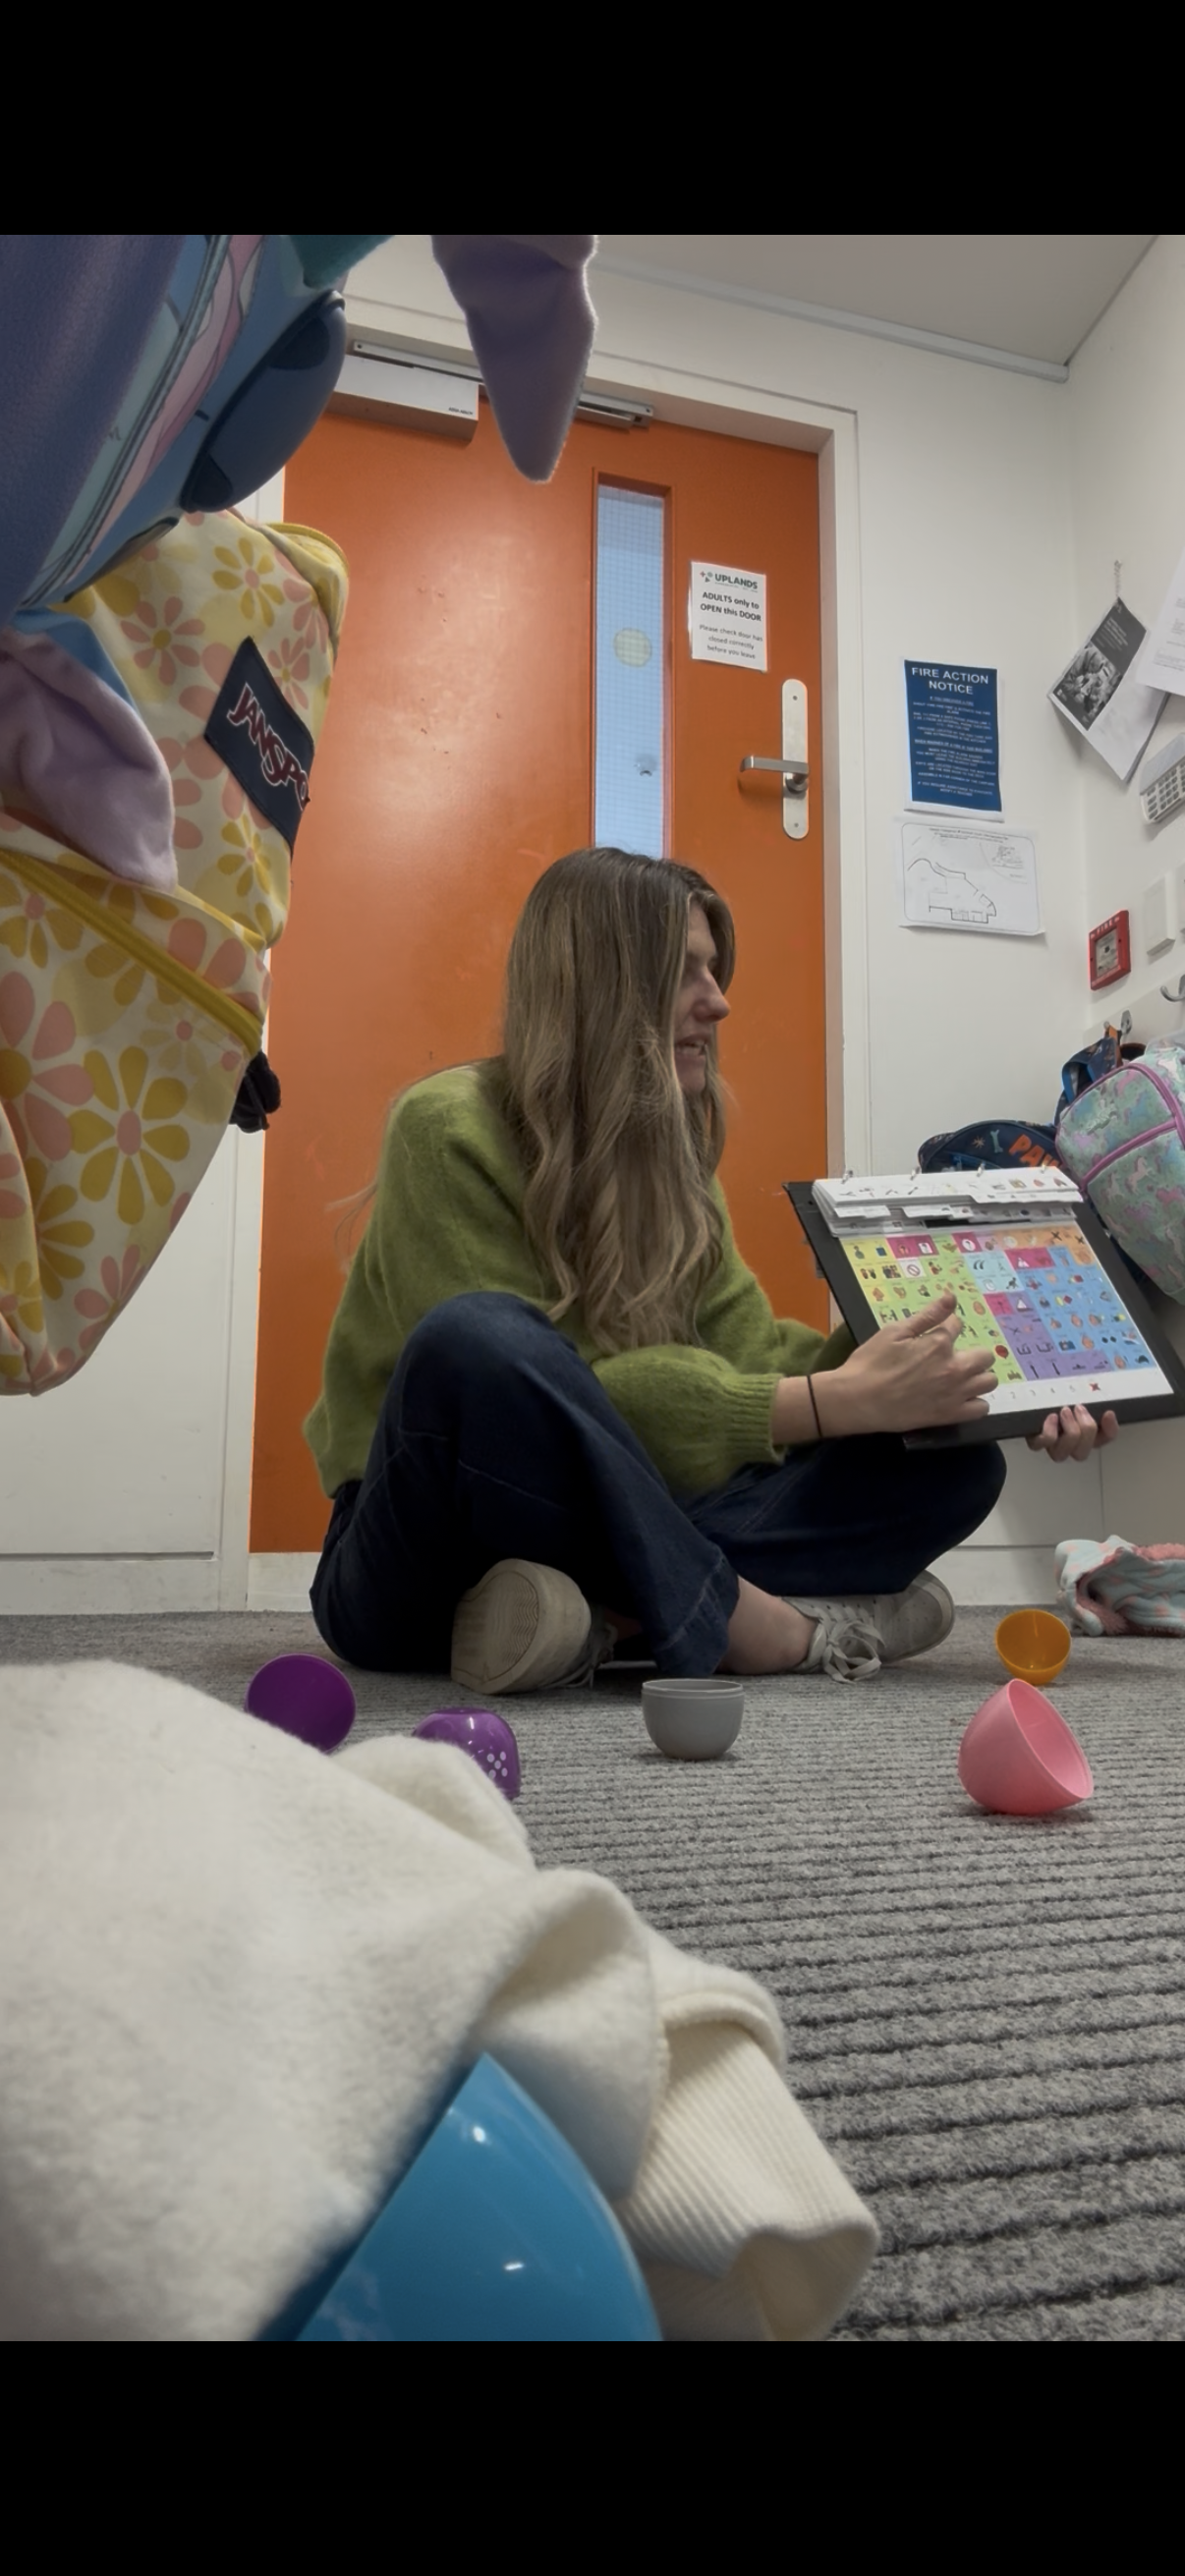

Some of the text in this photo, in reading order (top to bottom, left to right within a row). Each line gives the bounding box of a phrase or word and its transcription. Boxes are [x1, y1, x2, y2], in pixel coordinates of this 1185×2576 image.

[714, 573, 759, 589] UPLANDS
[703, 591, 760, 610] ADULTS only to
[700, 602, 762, 622] OPEN this DOOR
[700, 624, 718, 634] Please
[720, 627, 737, 636] check
[738, 630, 752, 640] door
[708, 636, 728, 644] closed
[706, 644, 756, 659] before you leave
[911, 667, 988, 685] FIRE ACTION
[929, 680, 974, 696] NOTICE
